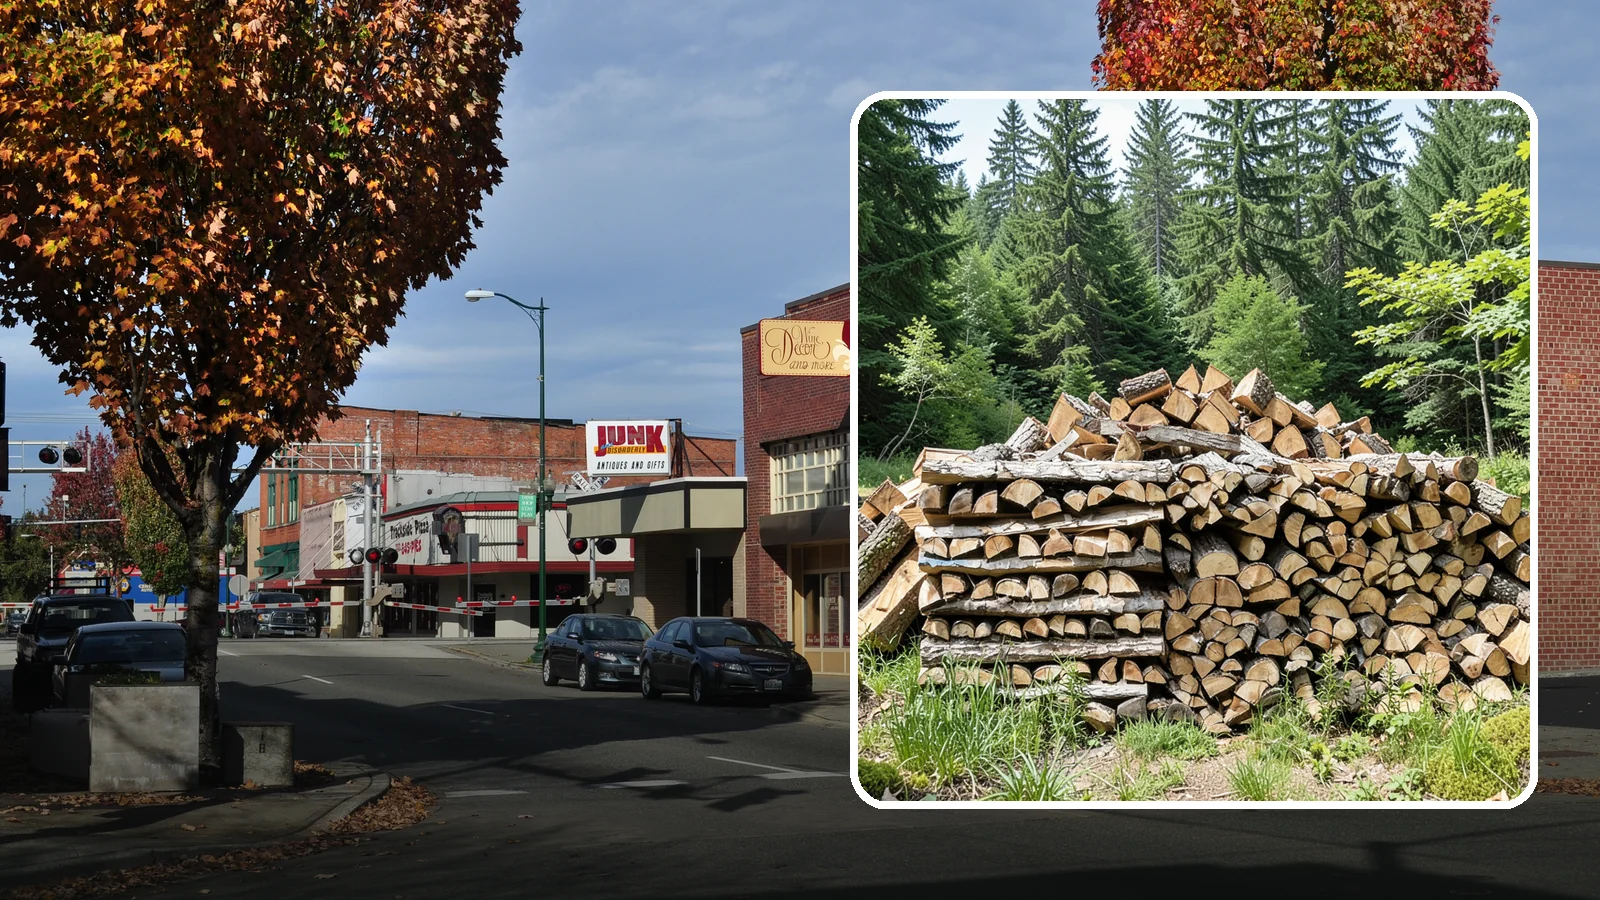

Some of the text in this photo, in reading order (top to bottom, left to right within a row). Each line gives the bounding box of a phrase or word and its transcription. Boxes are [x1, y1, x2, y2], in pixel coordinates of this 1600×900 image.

[595, 425, 664, 457] JUNK
[607, 446, 646, 454] DISORDERLY
[597, 460, 665, 470] ANTIQUES AND GIFTS
[390, 520, 429, 539] Trackside Pizza
